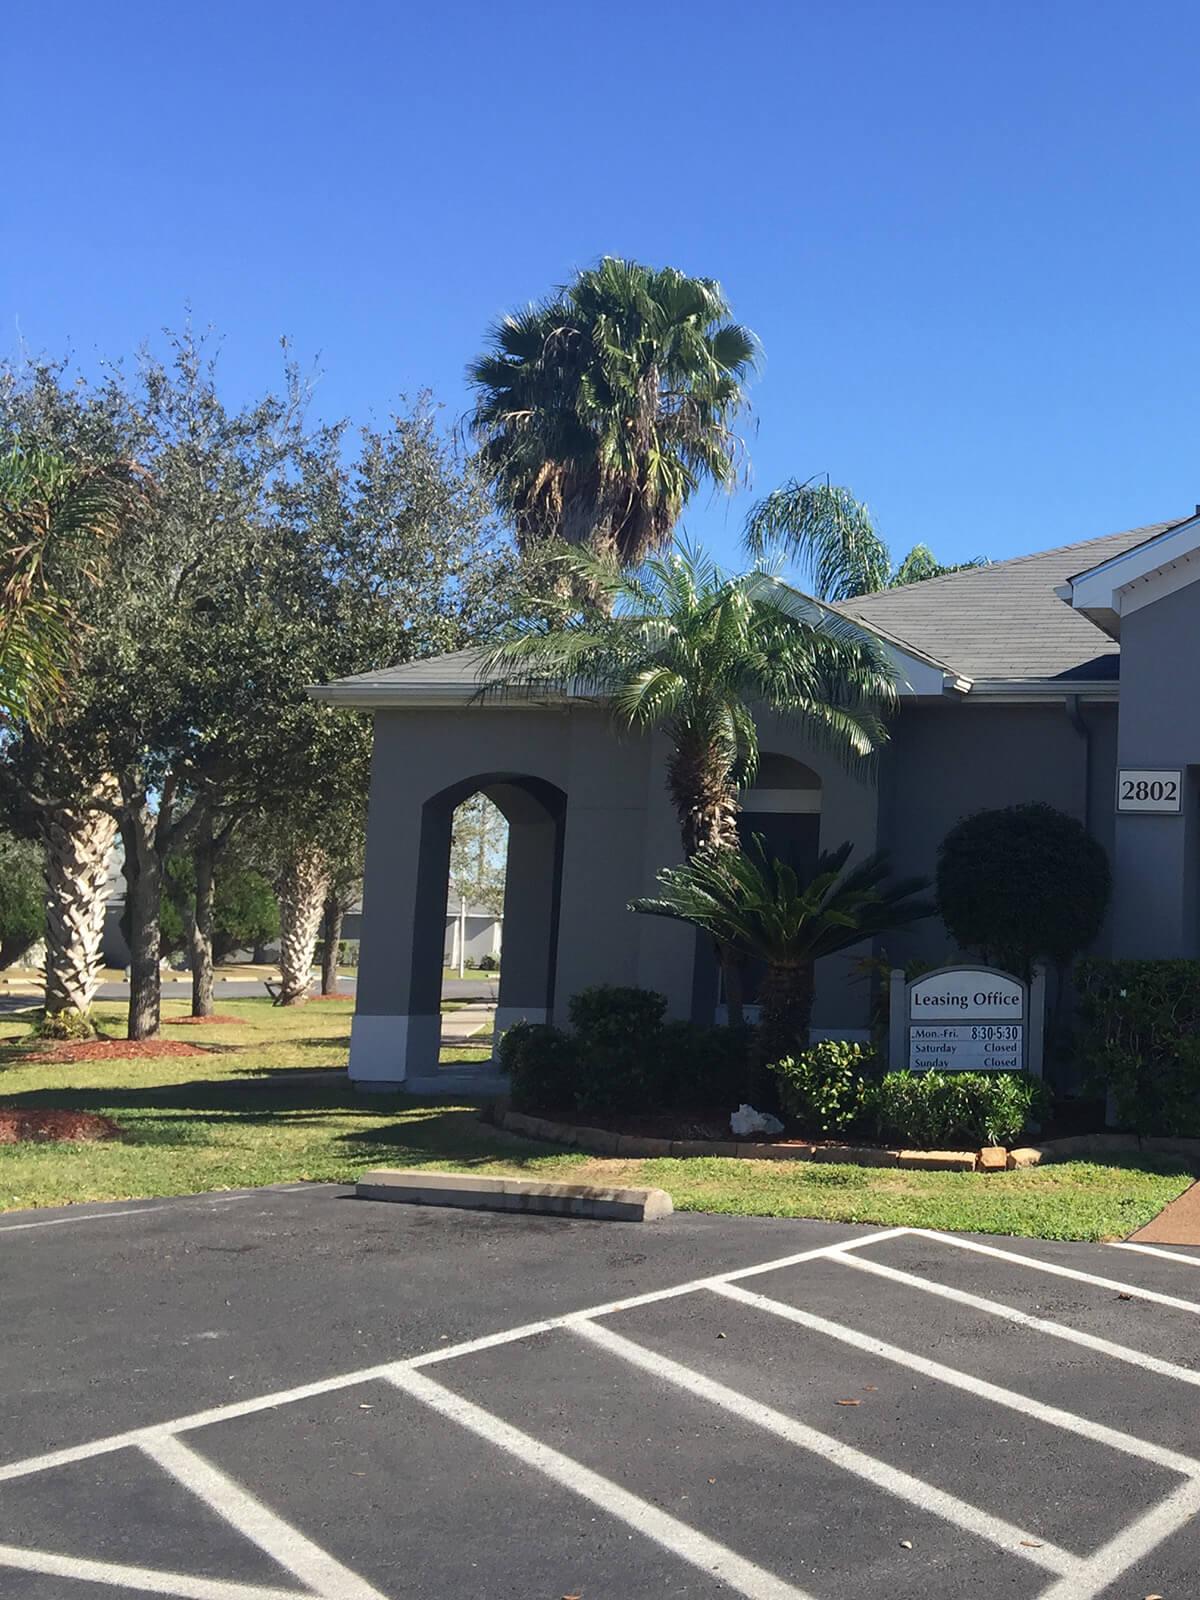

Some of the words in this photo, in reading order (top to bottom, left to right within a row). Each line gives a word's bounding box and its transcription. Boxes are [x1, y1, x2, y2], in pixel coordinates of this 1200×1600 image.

[1122, 781, 1177, 801] 2802
[914, 992, 969, 1010] Leasing
[973, 992, 1020, 1006] Office
[971, 1026, 1018, 1041] 8:30-5:30
[915, 1043, 957, 1055] Saturday
[984, 1043, 1017, 1053] Closed
[915, 1058, 949, 1068] Sunday
[984, 1058, 1017, 1068] Closed
